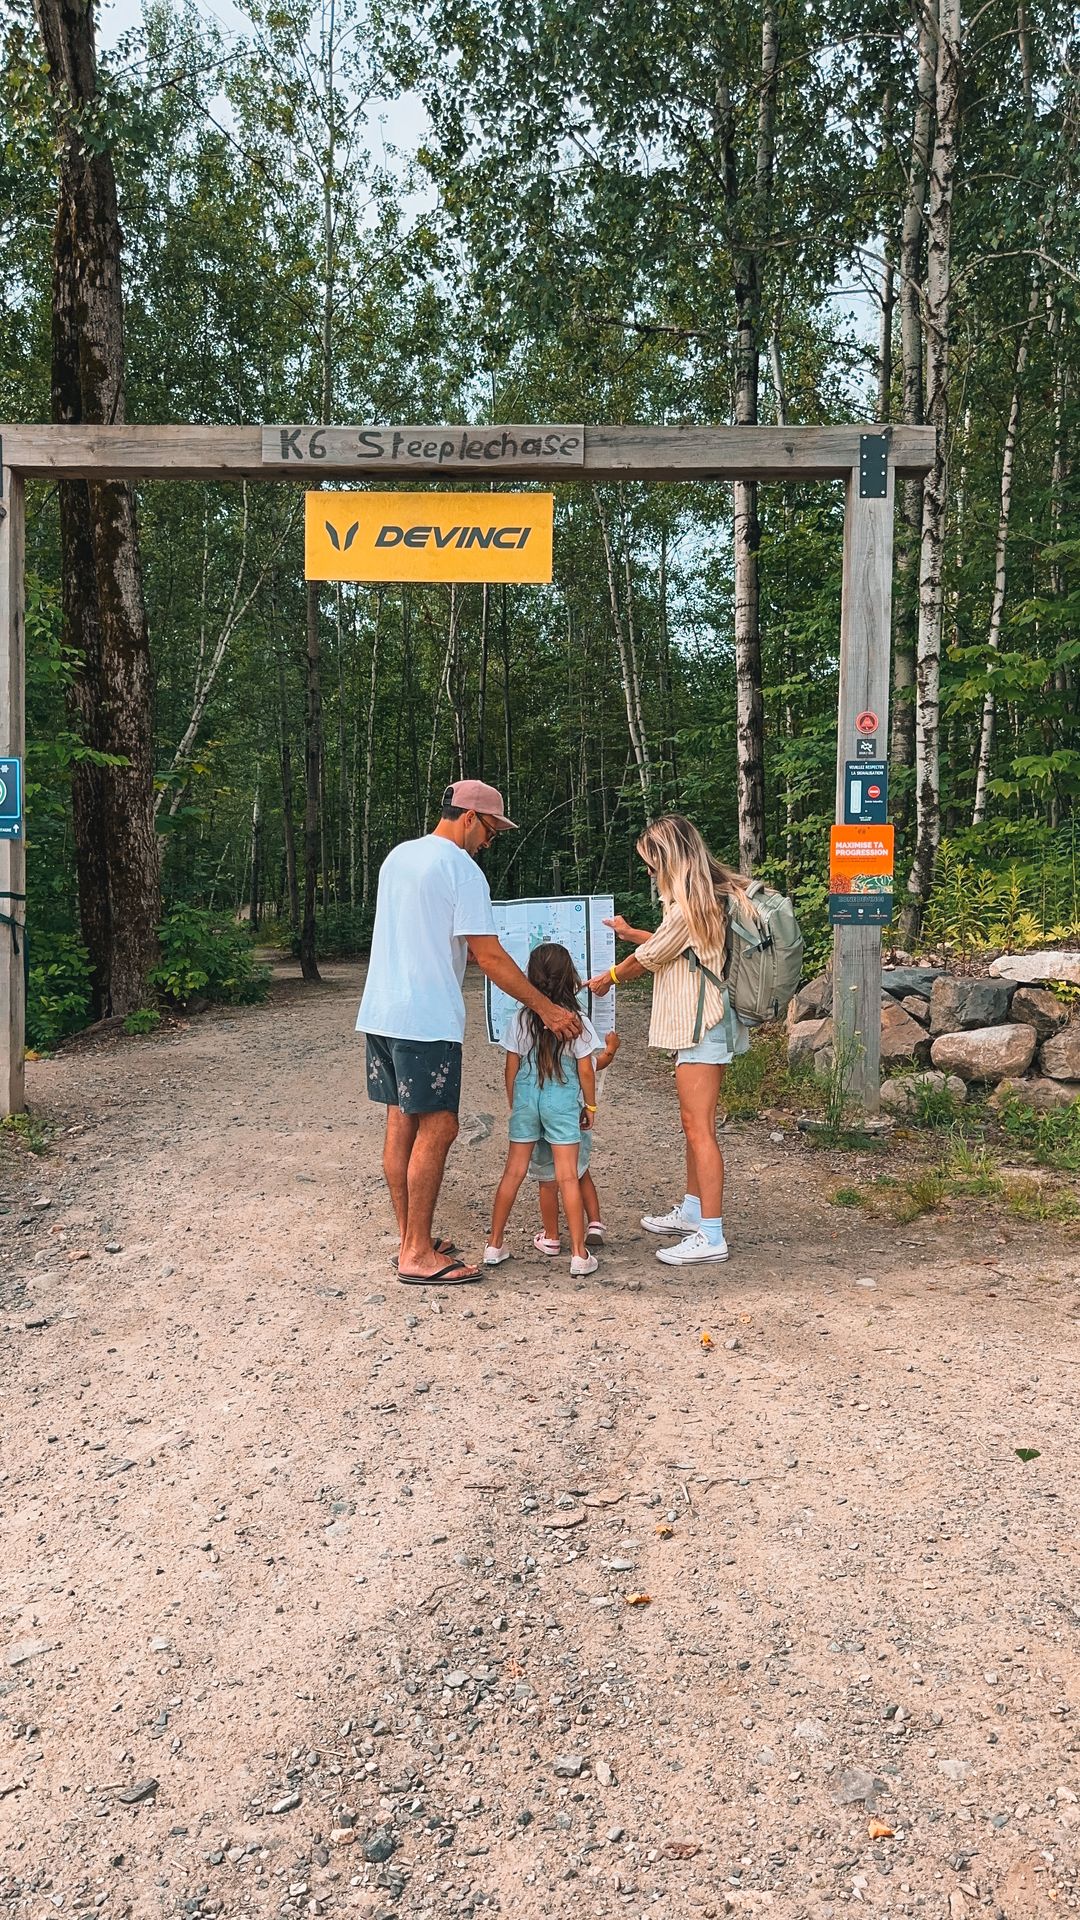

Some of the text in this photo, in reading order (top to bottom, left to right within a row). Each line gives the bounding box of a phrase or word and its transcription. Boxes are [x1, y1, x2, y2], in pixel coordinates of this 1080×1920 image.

[279, 429, 580, 463] K6 Steeplechase
[374, 525, 532, 549] DEVINCI
[835, 841, 883, 849] MAXIMISE TA
